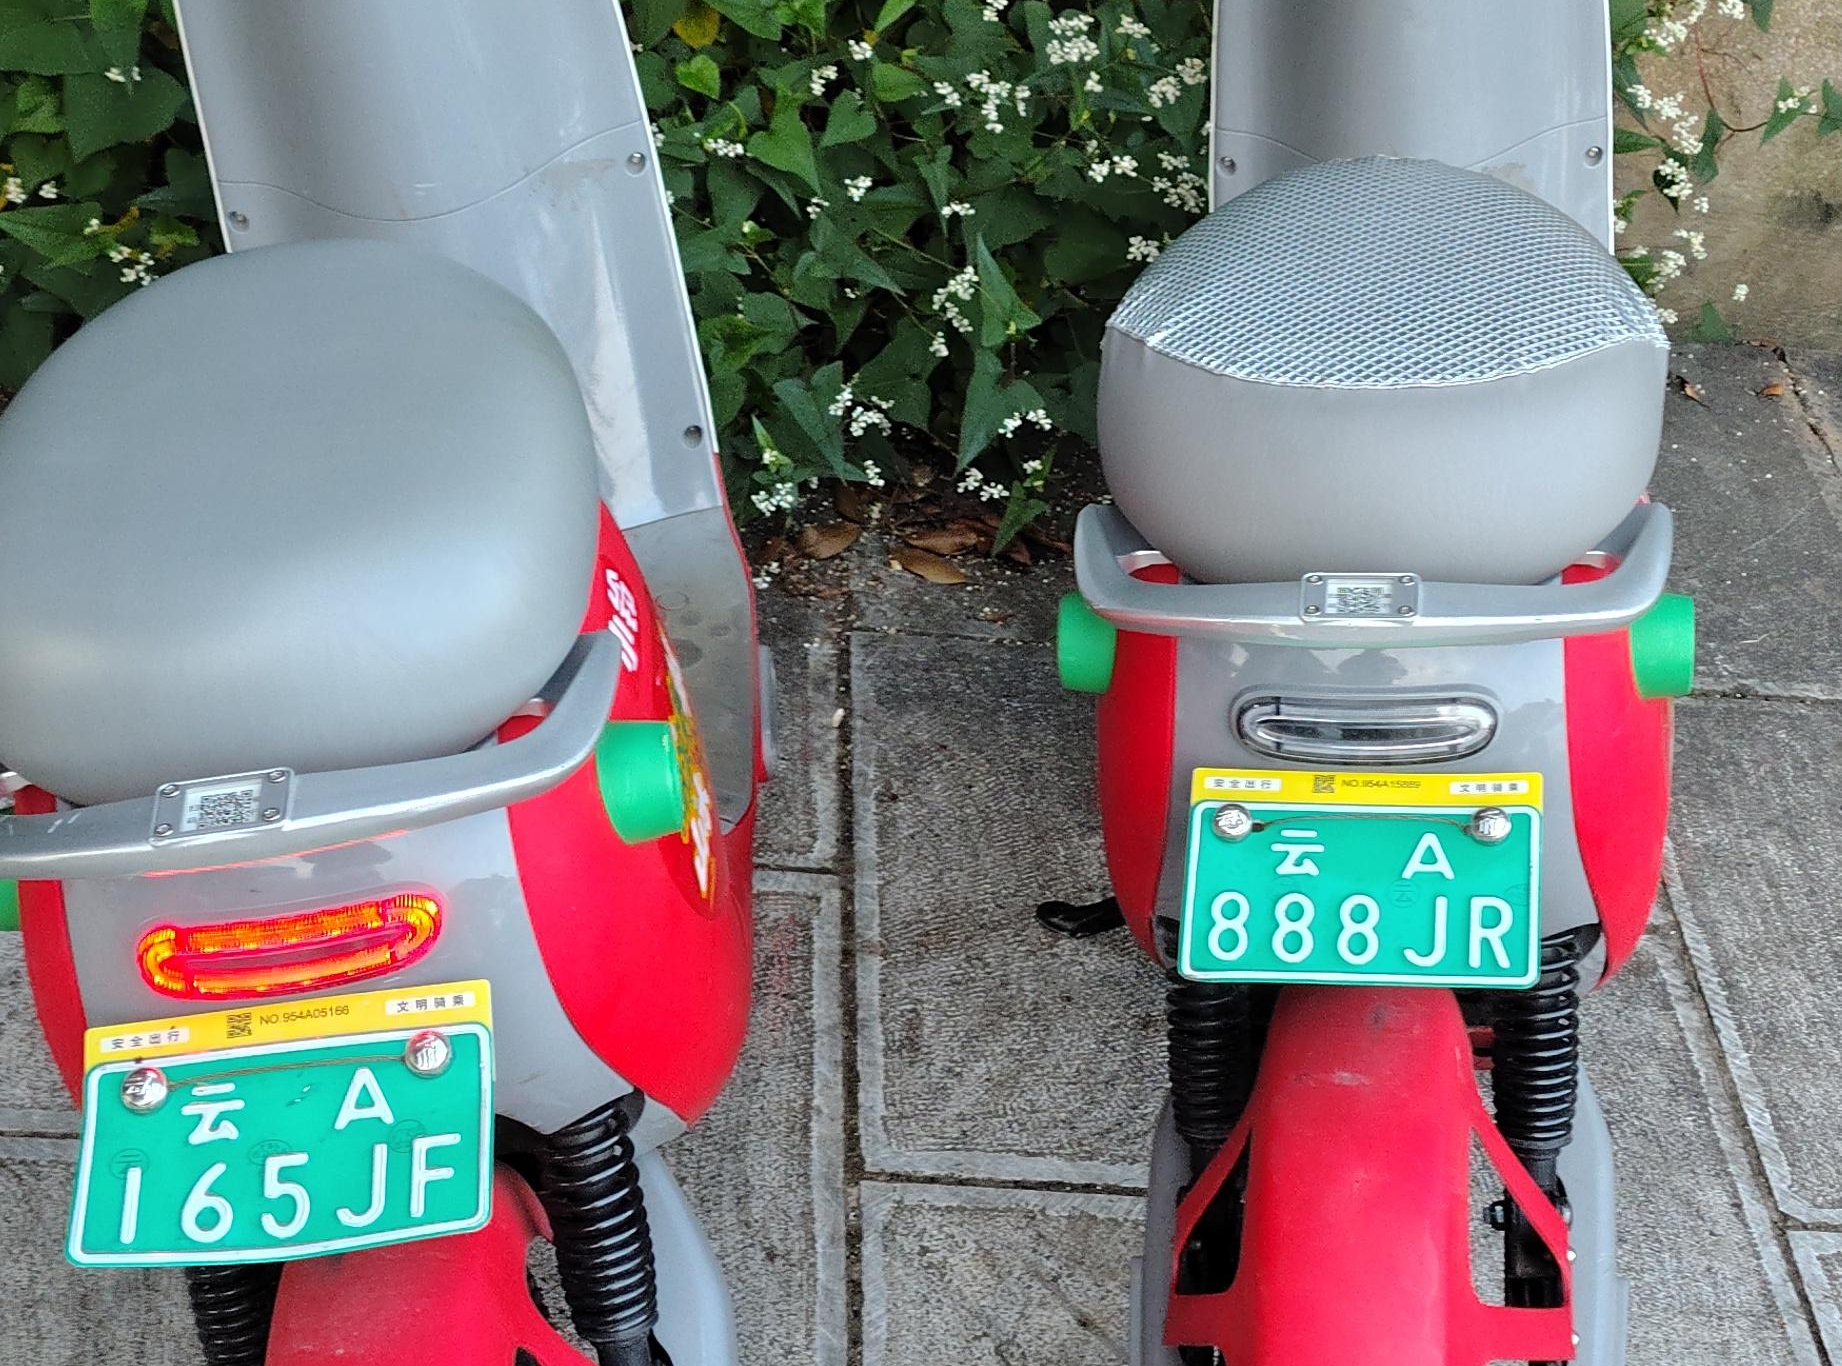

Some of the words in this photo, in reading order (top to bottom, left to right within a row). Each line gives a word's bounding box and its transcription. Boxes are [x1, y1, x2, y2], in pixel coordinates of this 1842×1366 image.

[1270, 829, 1326, 877] 云
[1400, 832, 1456, 880] A
[1207, 890, 1514, 970] 888JR
[180, 1082, 246, 1146] 云
[333, 1066, 395, 1131] A
[118, 1132, 462, 1245] 165JF
